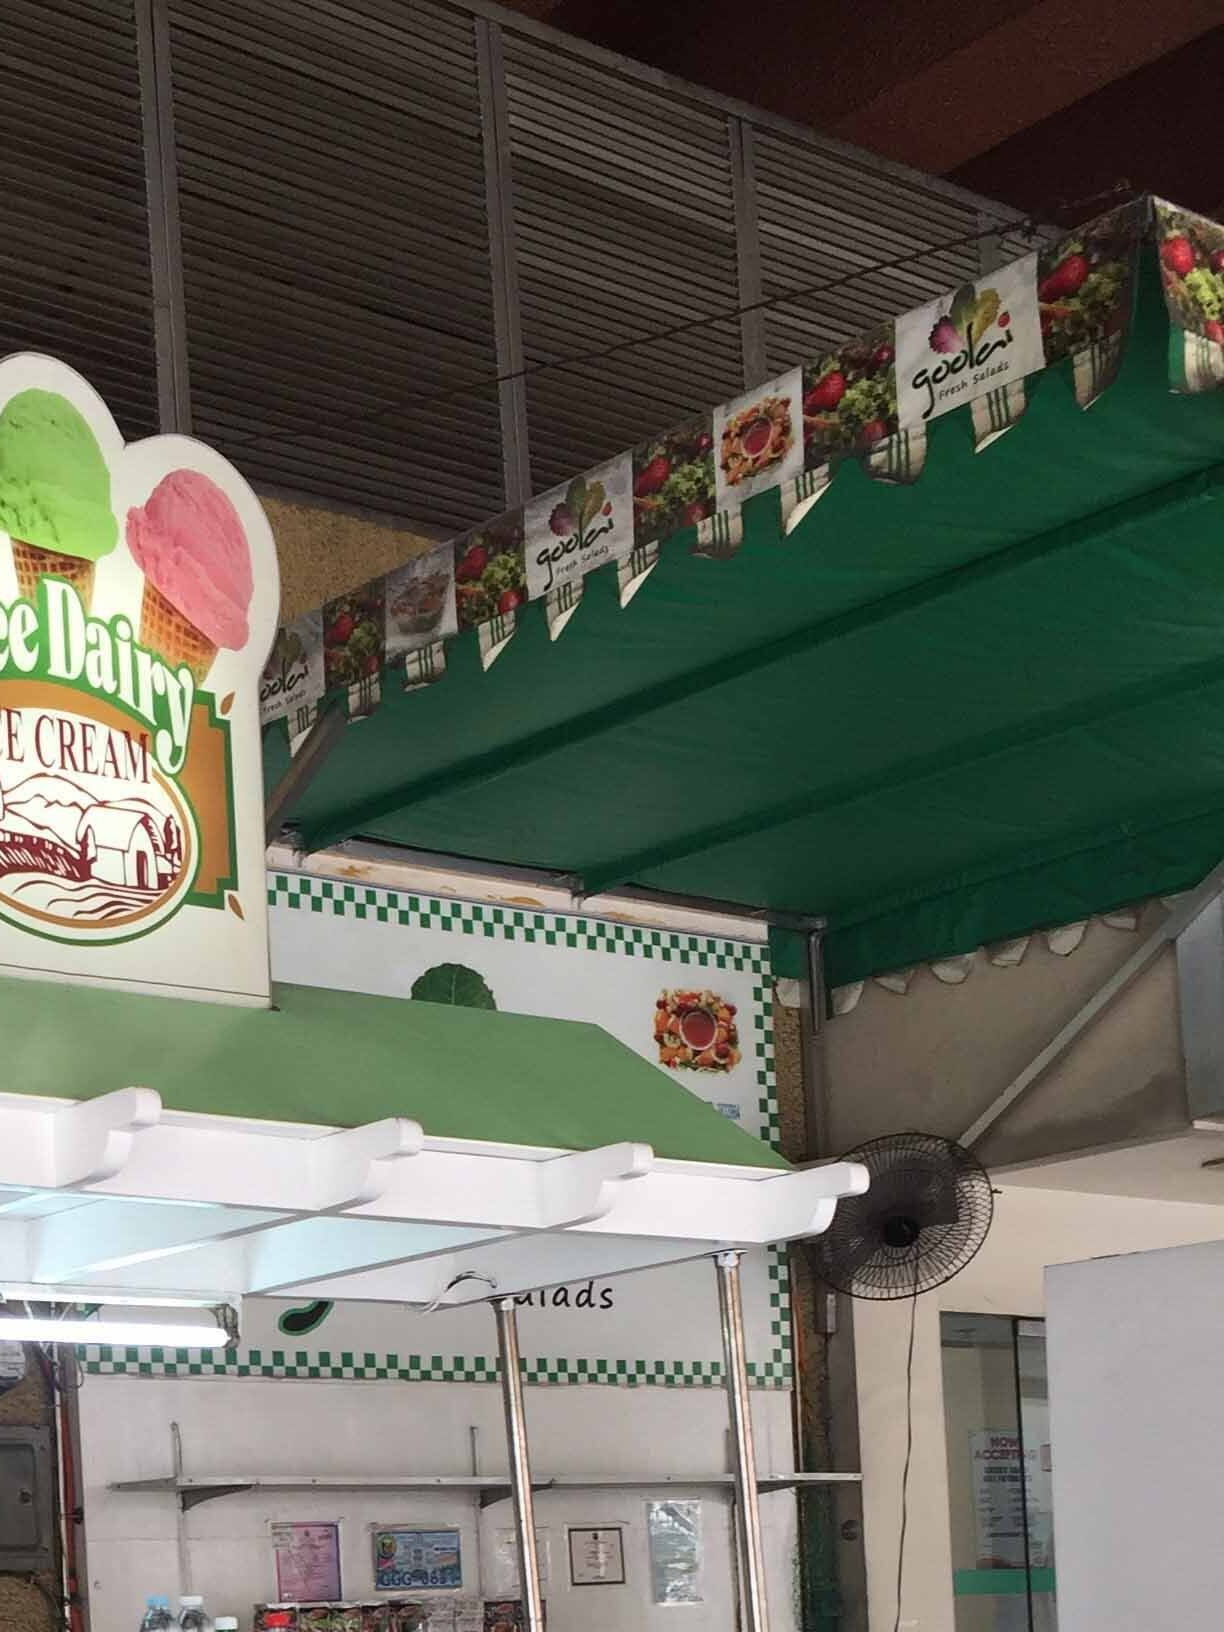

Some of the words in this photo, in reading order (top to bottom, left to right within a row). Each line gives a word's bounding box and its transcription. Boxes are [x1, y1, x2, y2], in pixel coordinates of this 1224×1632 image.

[42, 578, 195, 763] Dairy
[261, 658, 309, 702] oolai
[34, 714, 152, 784] CREAM
[514, 1280, 614, 1310] alads
